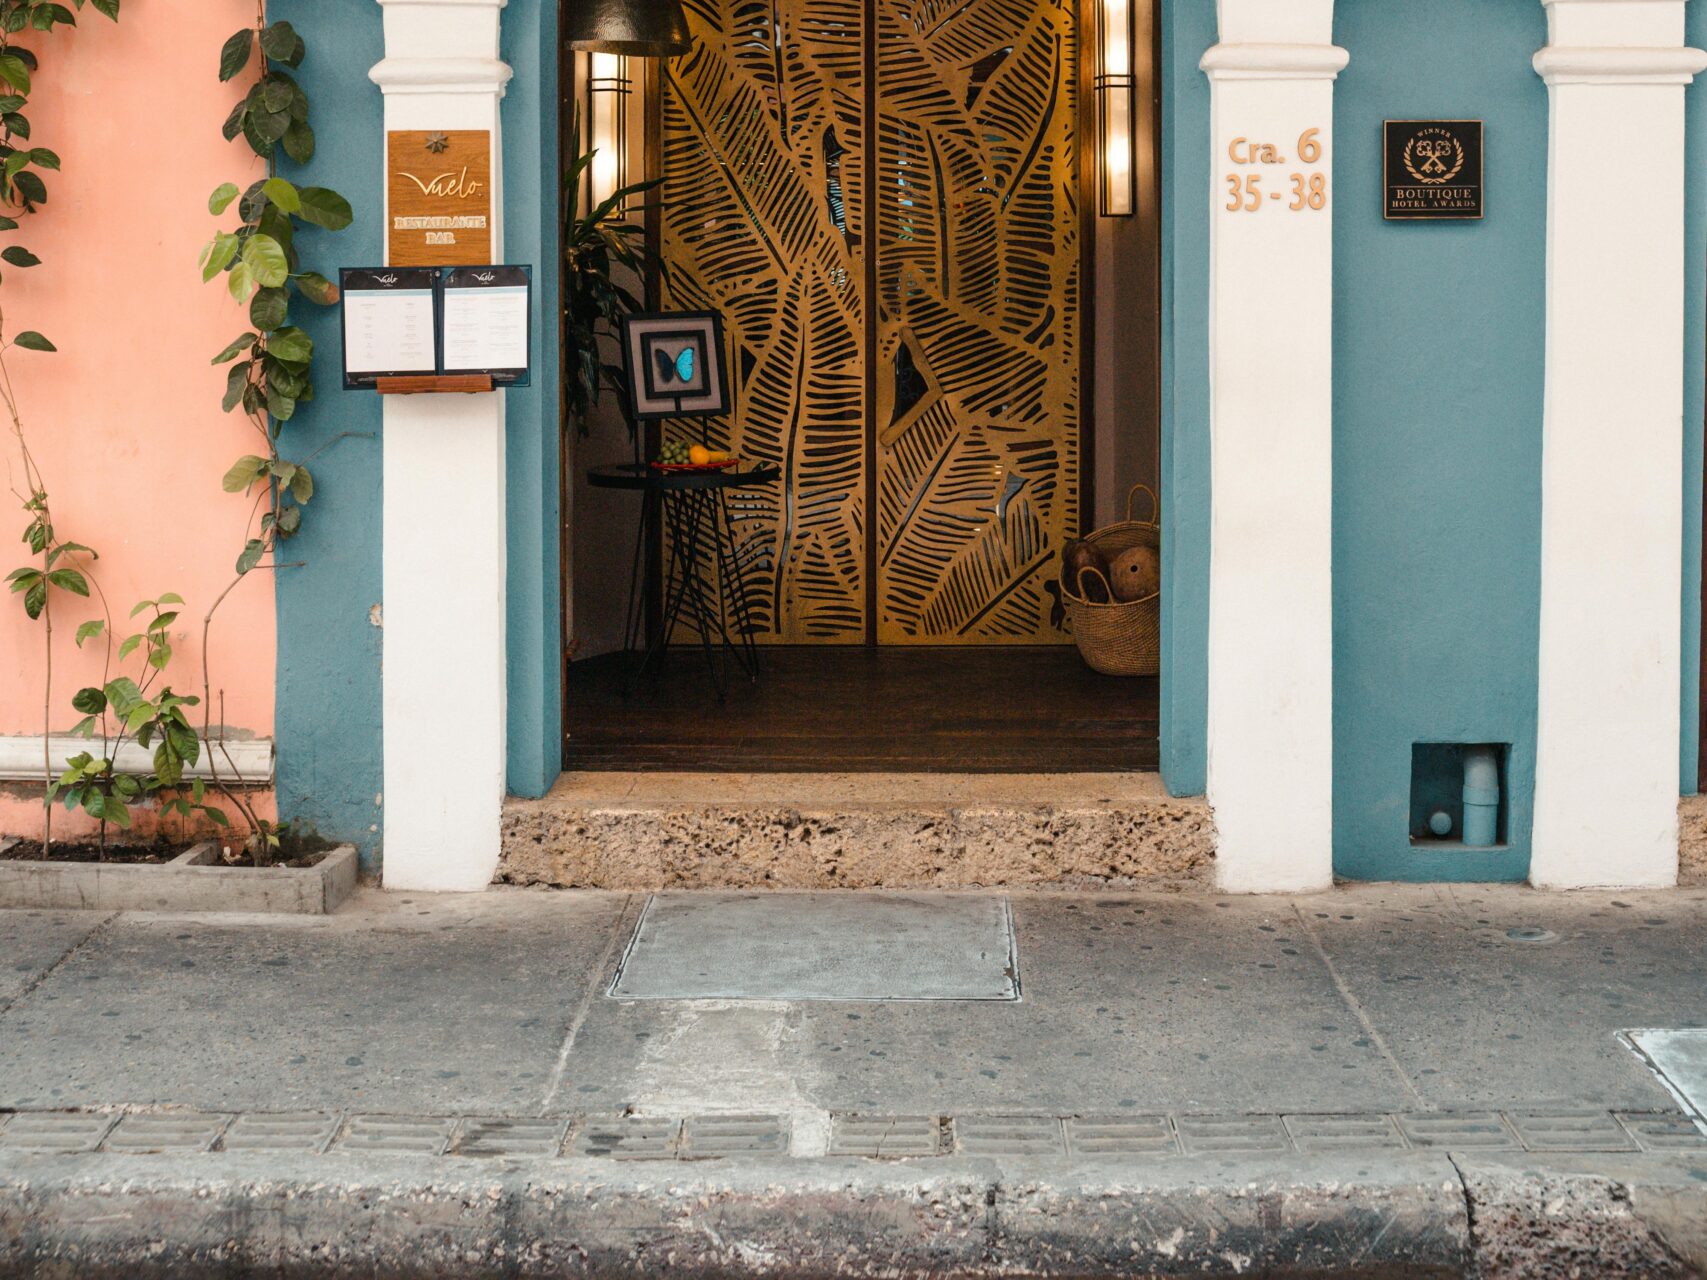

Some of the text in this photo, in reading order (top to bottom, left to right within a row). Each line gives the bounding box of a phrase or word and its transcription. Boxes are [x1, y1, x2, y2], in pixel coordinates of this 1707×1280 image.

[1417, 127, 1452, 139] WINNER
[1228, 127, 1322, 164] Cra. 6
[1396, 188, 1473, 200] BOUTIQUE
[1391, 200, 1477, 209] HOTEL AWARDS
[393, 215, 487, 230] RESTAURANTE
[425, 232, 456, 245] BAR
